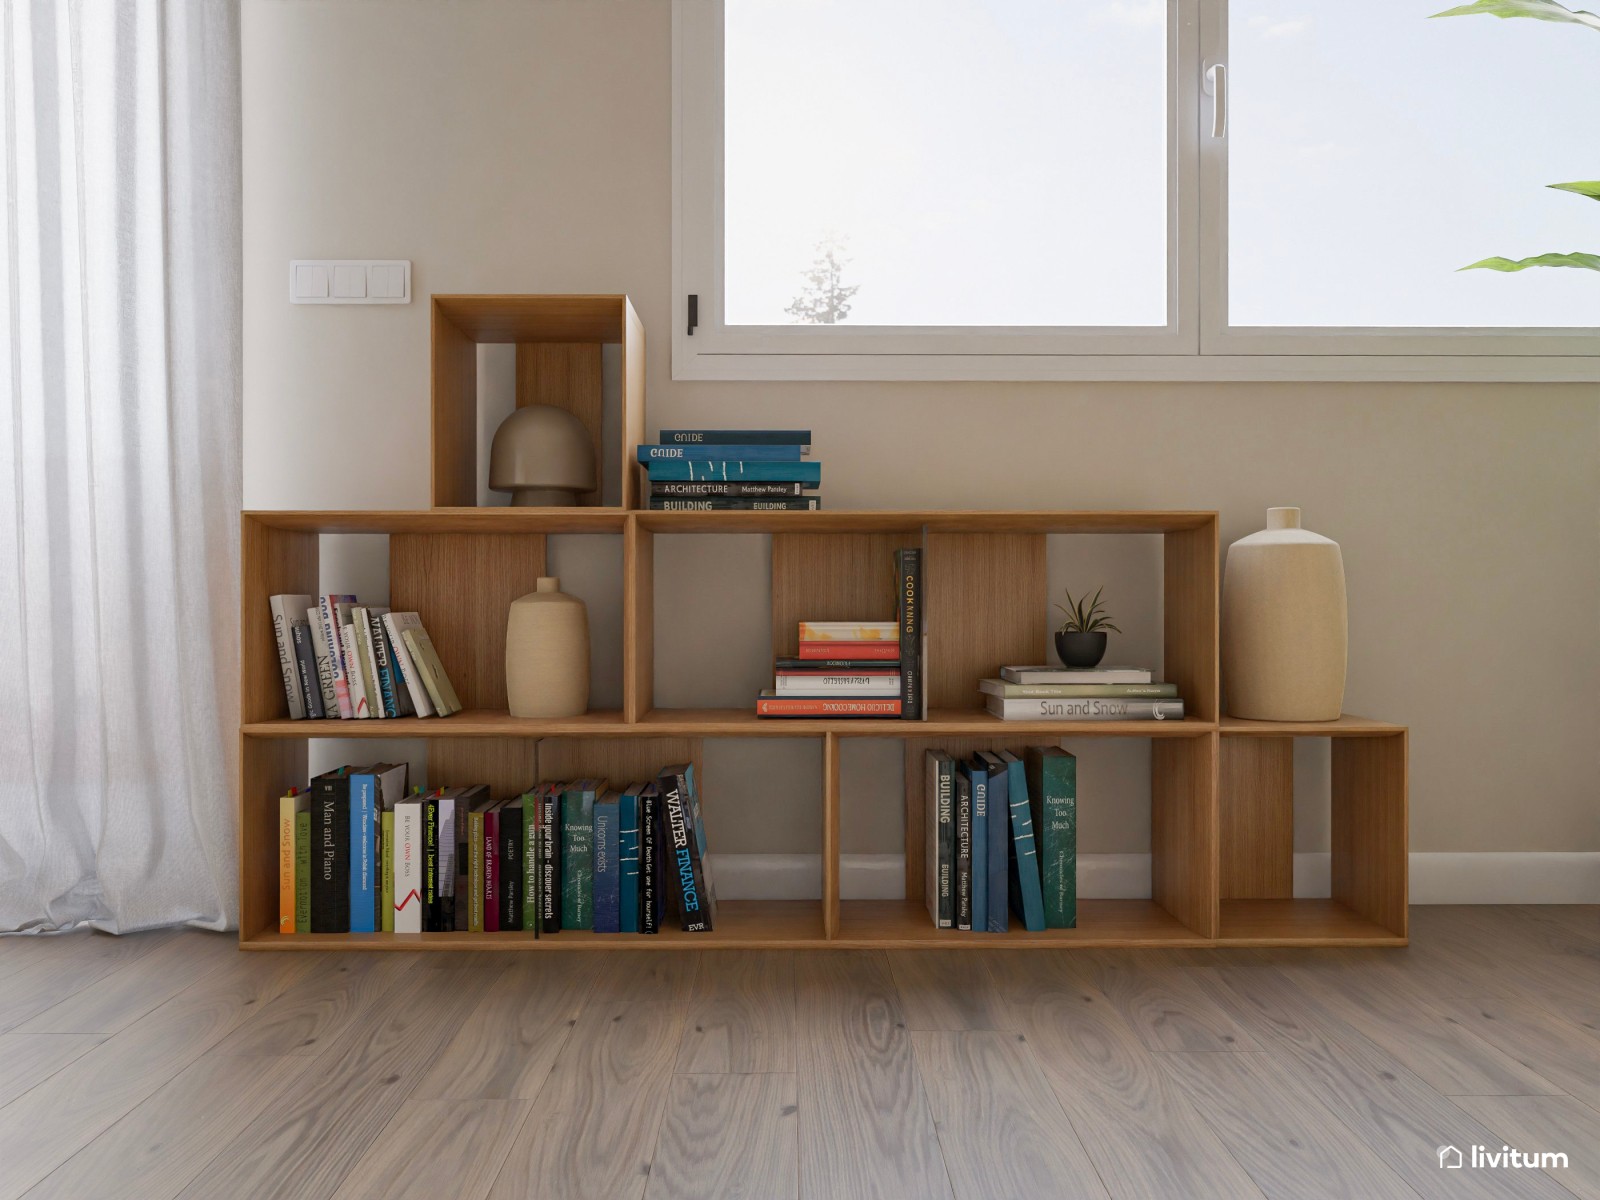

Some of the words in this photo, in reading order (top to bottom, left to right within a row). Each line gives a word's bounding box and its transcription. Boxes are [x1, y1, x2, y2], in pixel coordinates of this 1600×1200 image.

[664, 484, 728, 494] ARCHITECTURE
[741, 485, 766, 493] Matthew
[663, 501, 713, 511] BUILDING
[319, 655, 335, 700] GREEN
[1040, 701, 1064, 716] Sun
[1066, 700, 1090, 715] and
[1093, 701, 1128, 716] Snow
[940, 775, 950, 824] BUILDING
[1047, 795, 1074, 805] Knowing
[323, 801, 335, 825] Man
[544, 803, 553, 824] Inside
[666, 789, 687, 848] WALTER
[282, 819, 291, 847] Snow
[541, 824, 551, 841] your
[565, 824, 592, 832] Knowing
[597, 816, 608, 850] Unicorns
[1052, 821, 1069, 829] Much
[323, 828, 335, 847] and
[282, 850, 291, 869] and
[544, 841, 553, 858] brain
[323, 850, 335, 881] Piano
[597, 851, 608, 872] exists
[282, 872, 291, 890] Sun
[544, 864, 553, 893] discover
[676, 848, 699, 912] FINANCE
[941, 864, 949, 897] BUILDING
[527, 884, 535, 903] How
[544, 894, 553, 919] secrets
[688, 923, 704, 931] EVR
